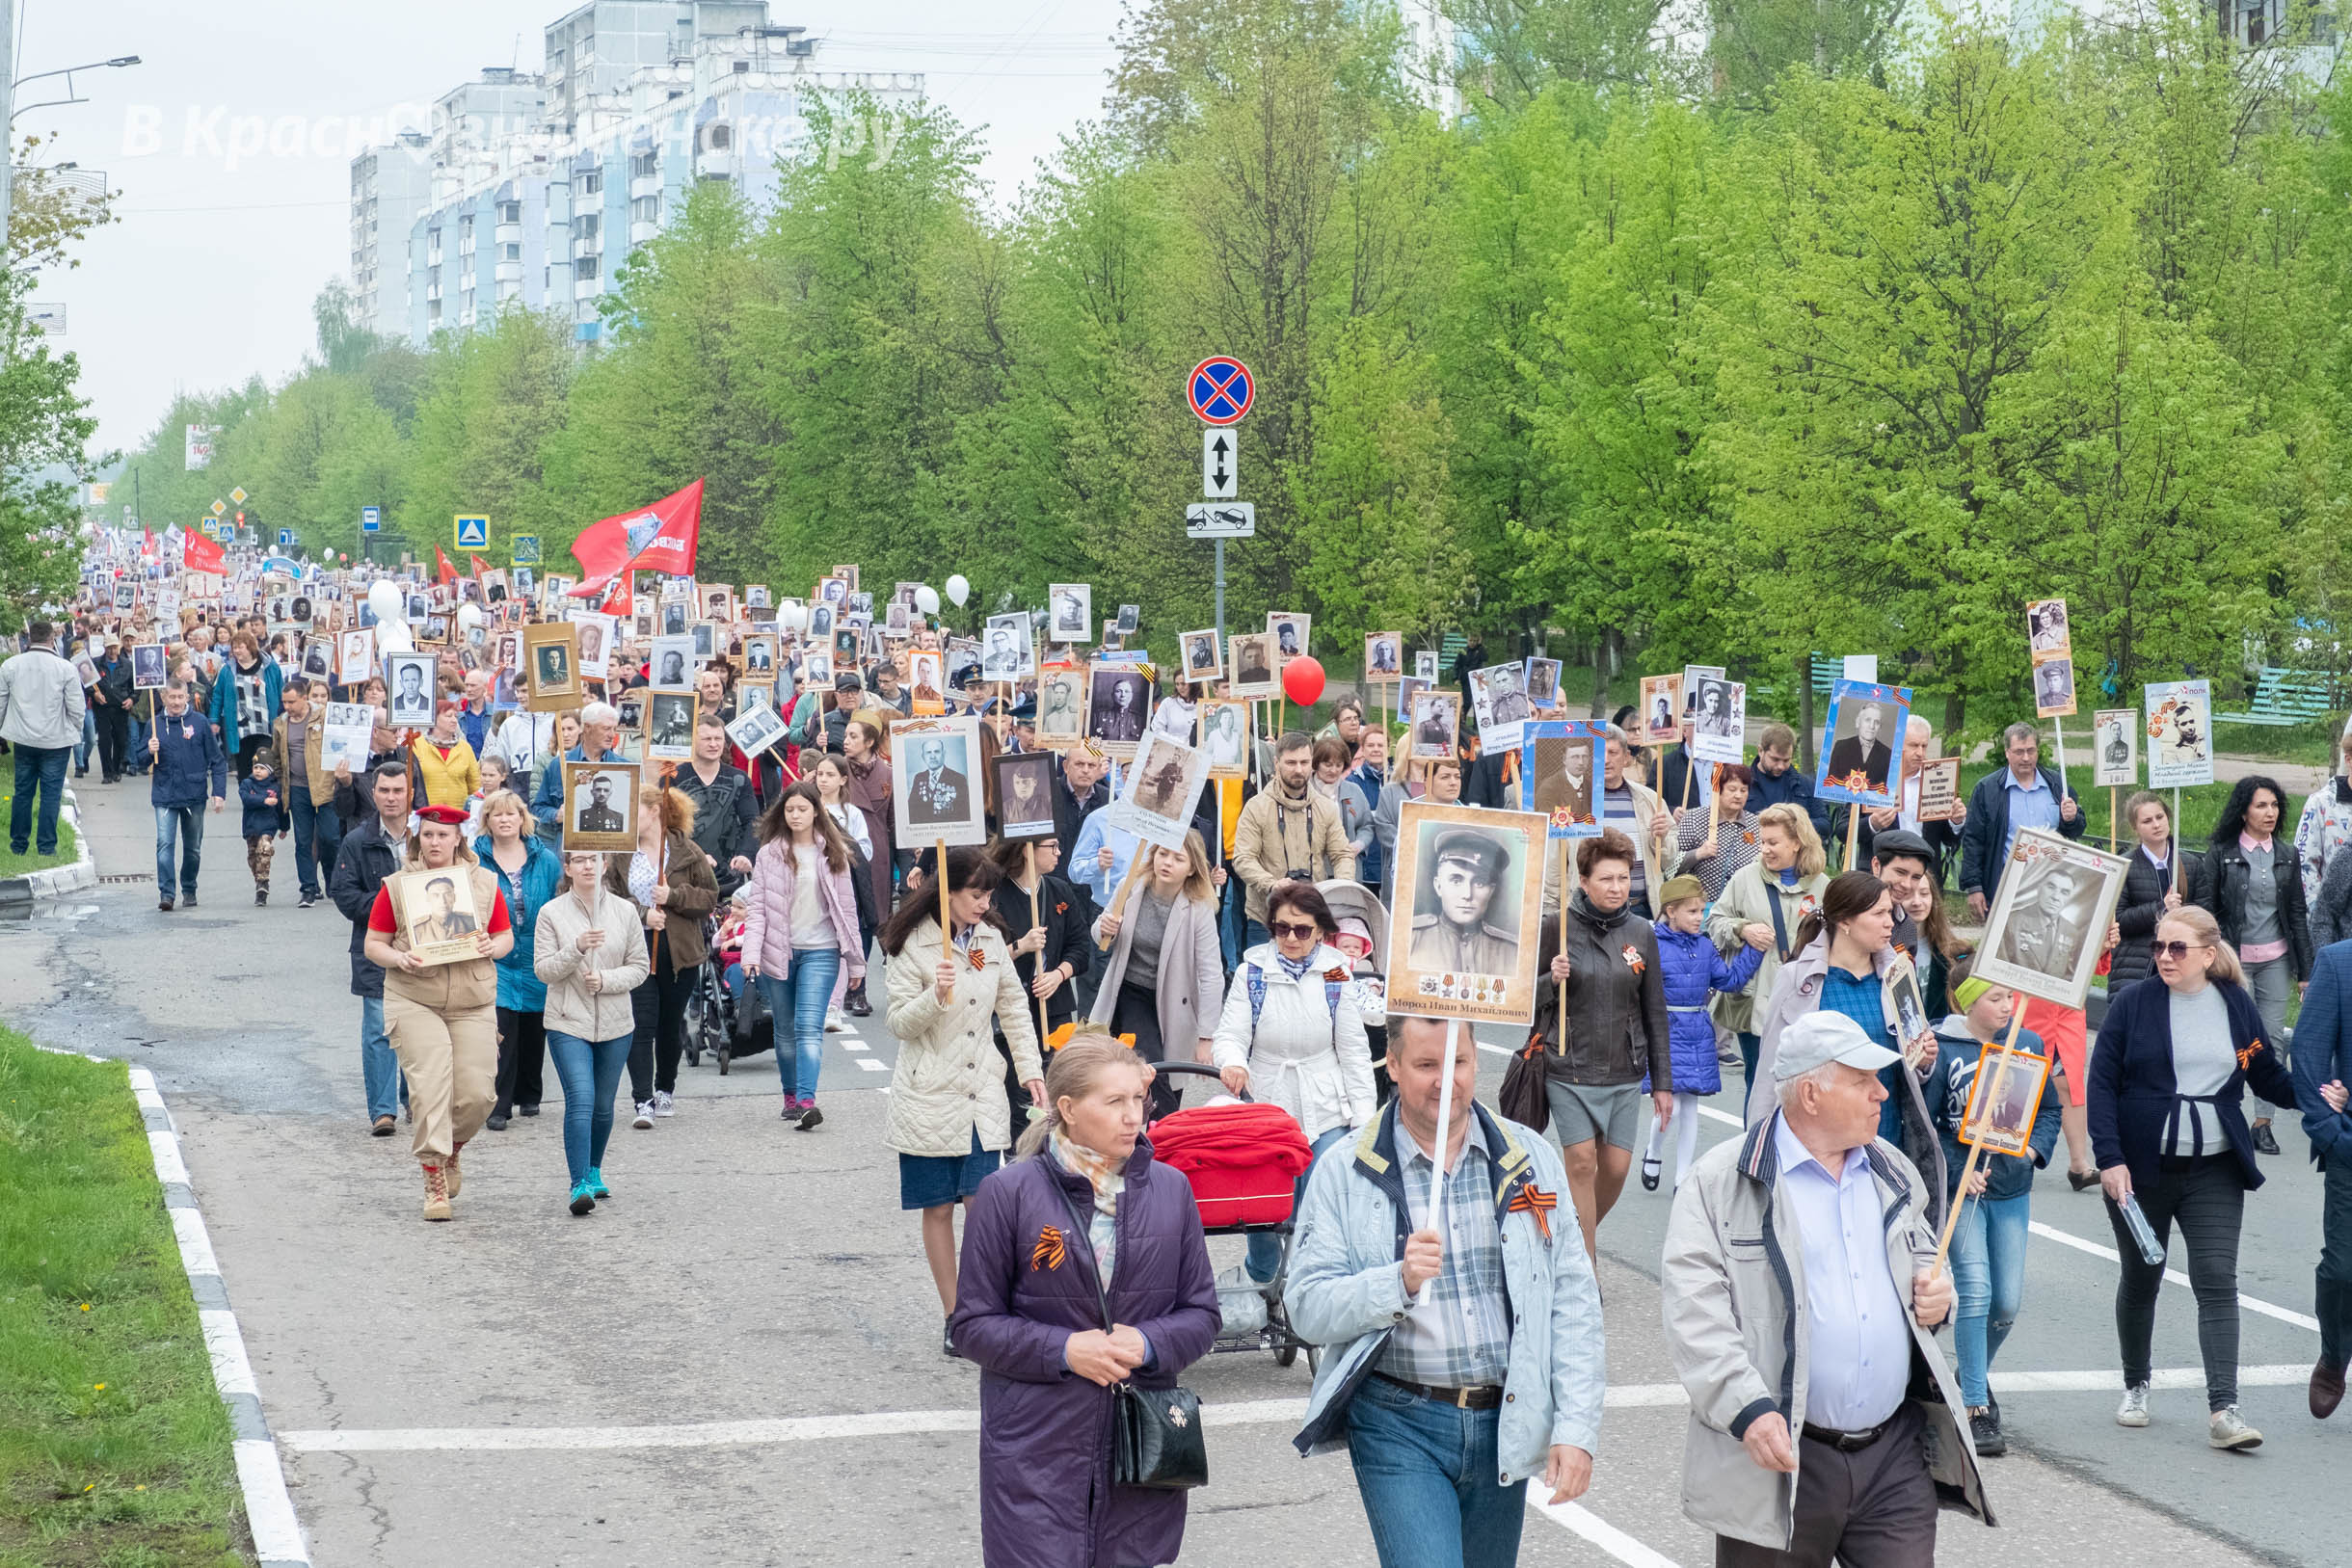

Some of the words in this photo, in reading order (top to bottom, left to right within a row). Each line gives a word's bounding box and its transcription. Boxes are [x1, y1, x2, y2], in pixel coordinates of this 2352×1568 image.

[1392, 998, 1427, 1009] Мороз
[1430, 1001, 1457, 1011] Иван
[1459, 1003, 1528, 1018] Михайлович
